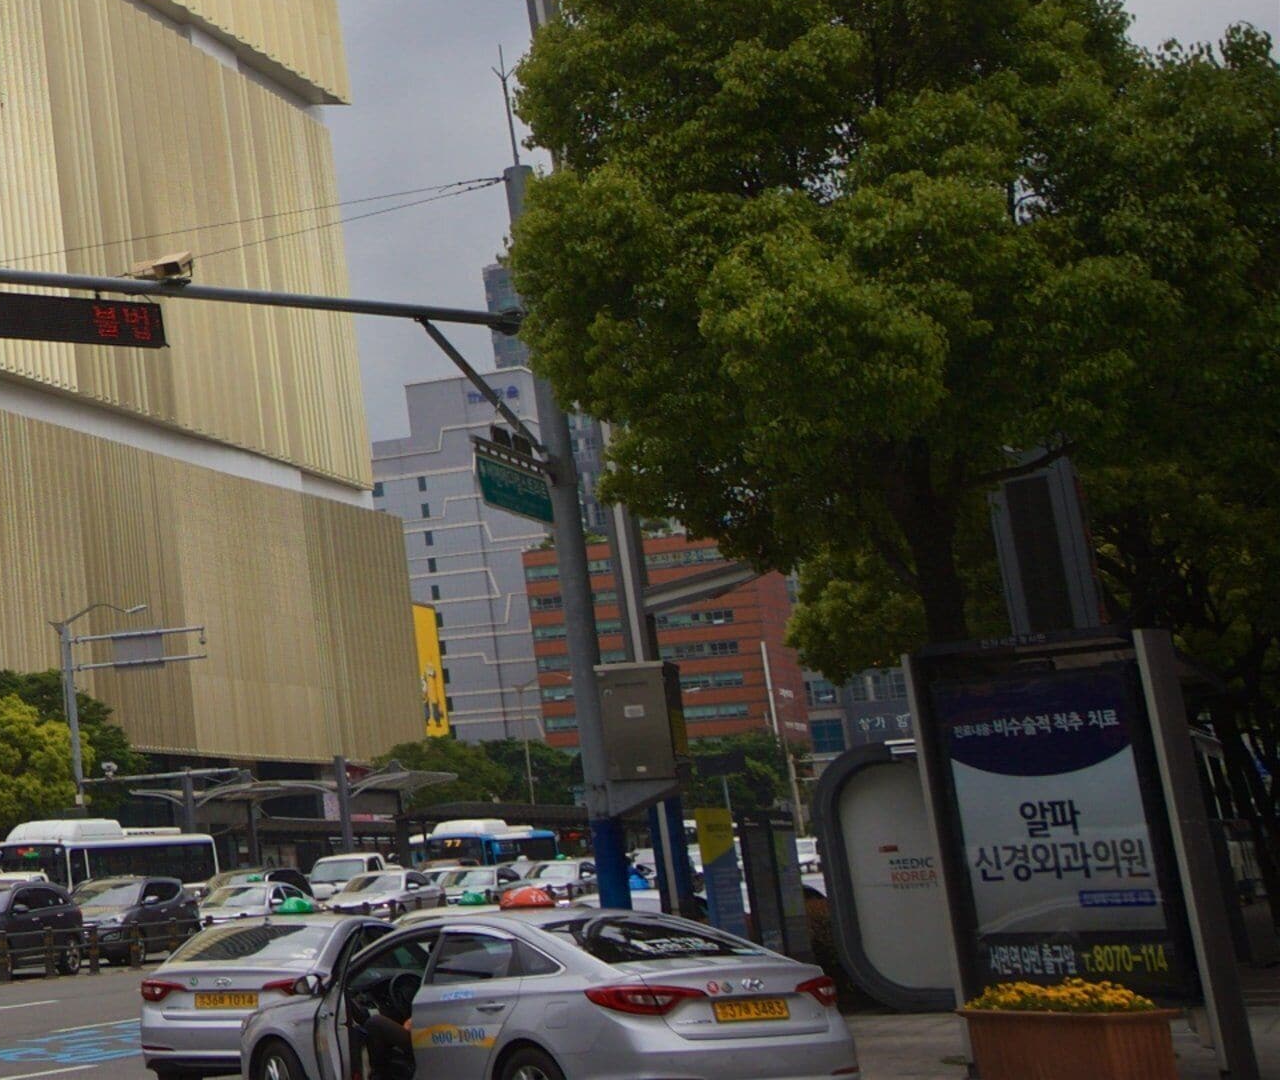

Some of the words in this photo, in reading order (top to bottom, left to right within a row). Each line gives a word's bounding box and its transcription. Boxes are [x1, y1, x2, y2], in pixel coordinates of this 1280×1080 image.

[993, 716, 1052, 737] 비수술적
[1053, 713, 1083, 732] 척추
[1088, 709, 1118, 728] 치료
[1019, 799, 1081, 839] 알파
[444, 839, 462, 847] 77
[975, 839, 1151, 882] 신경외과의원
[891, 870, 937, 883] KOREA
